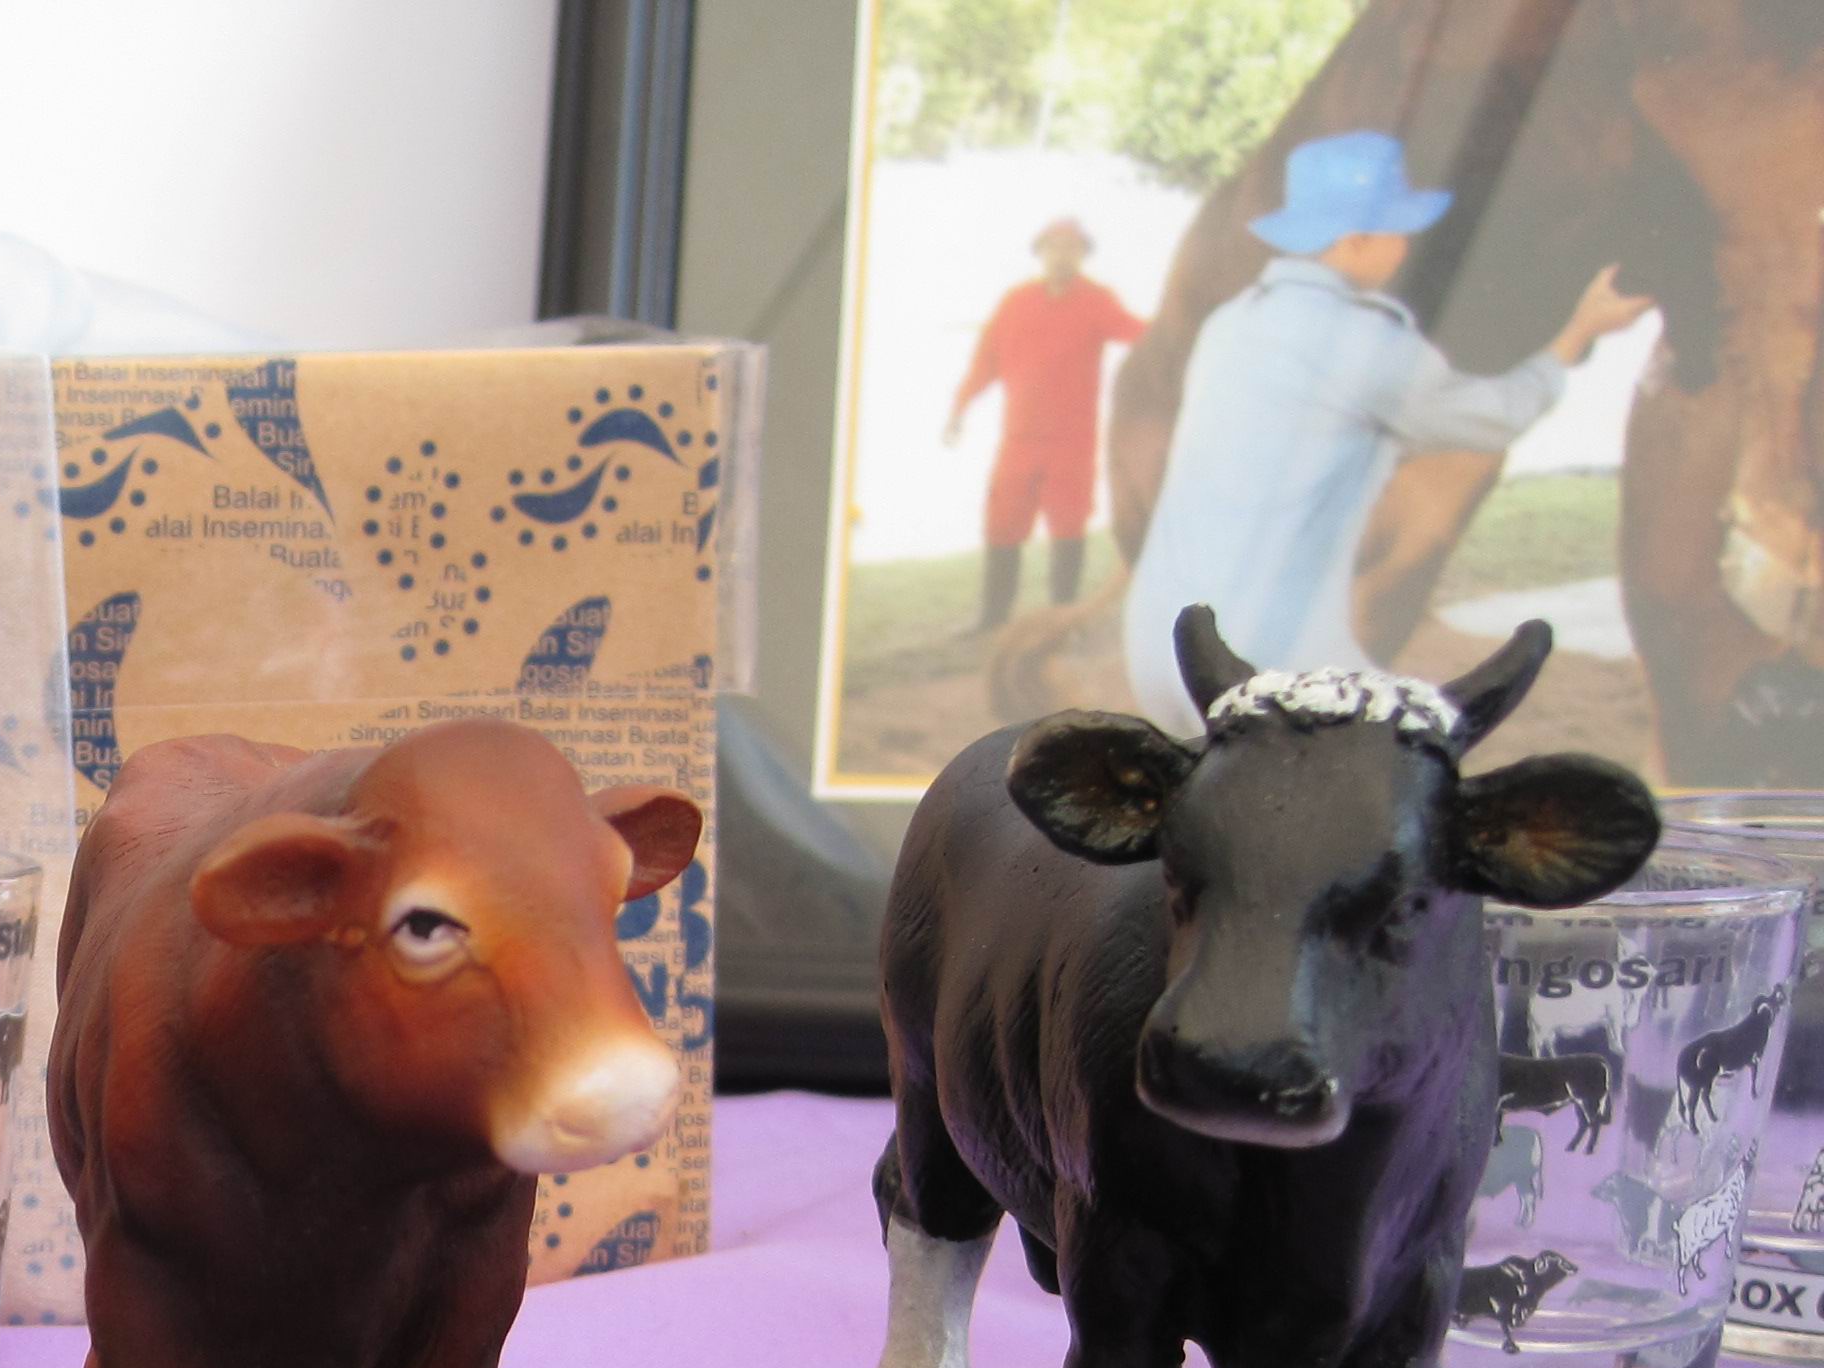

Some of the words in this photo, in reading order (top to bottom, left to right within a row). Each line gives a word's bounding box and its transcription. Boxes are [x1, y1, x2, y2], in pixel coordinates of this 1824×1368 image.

[213, 485, 280, 510] Balai
[202, 512, 331, 539] Insemina
[1731, 1277, 1806, 1319] OX
